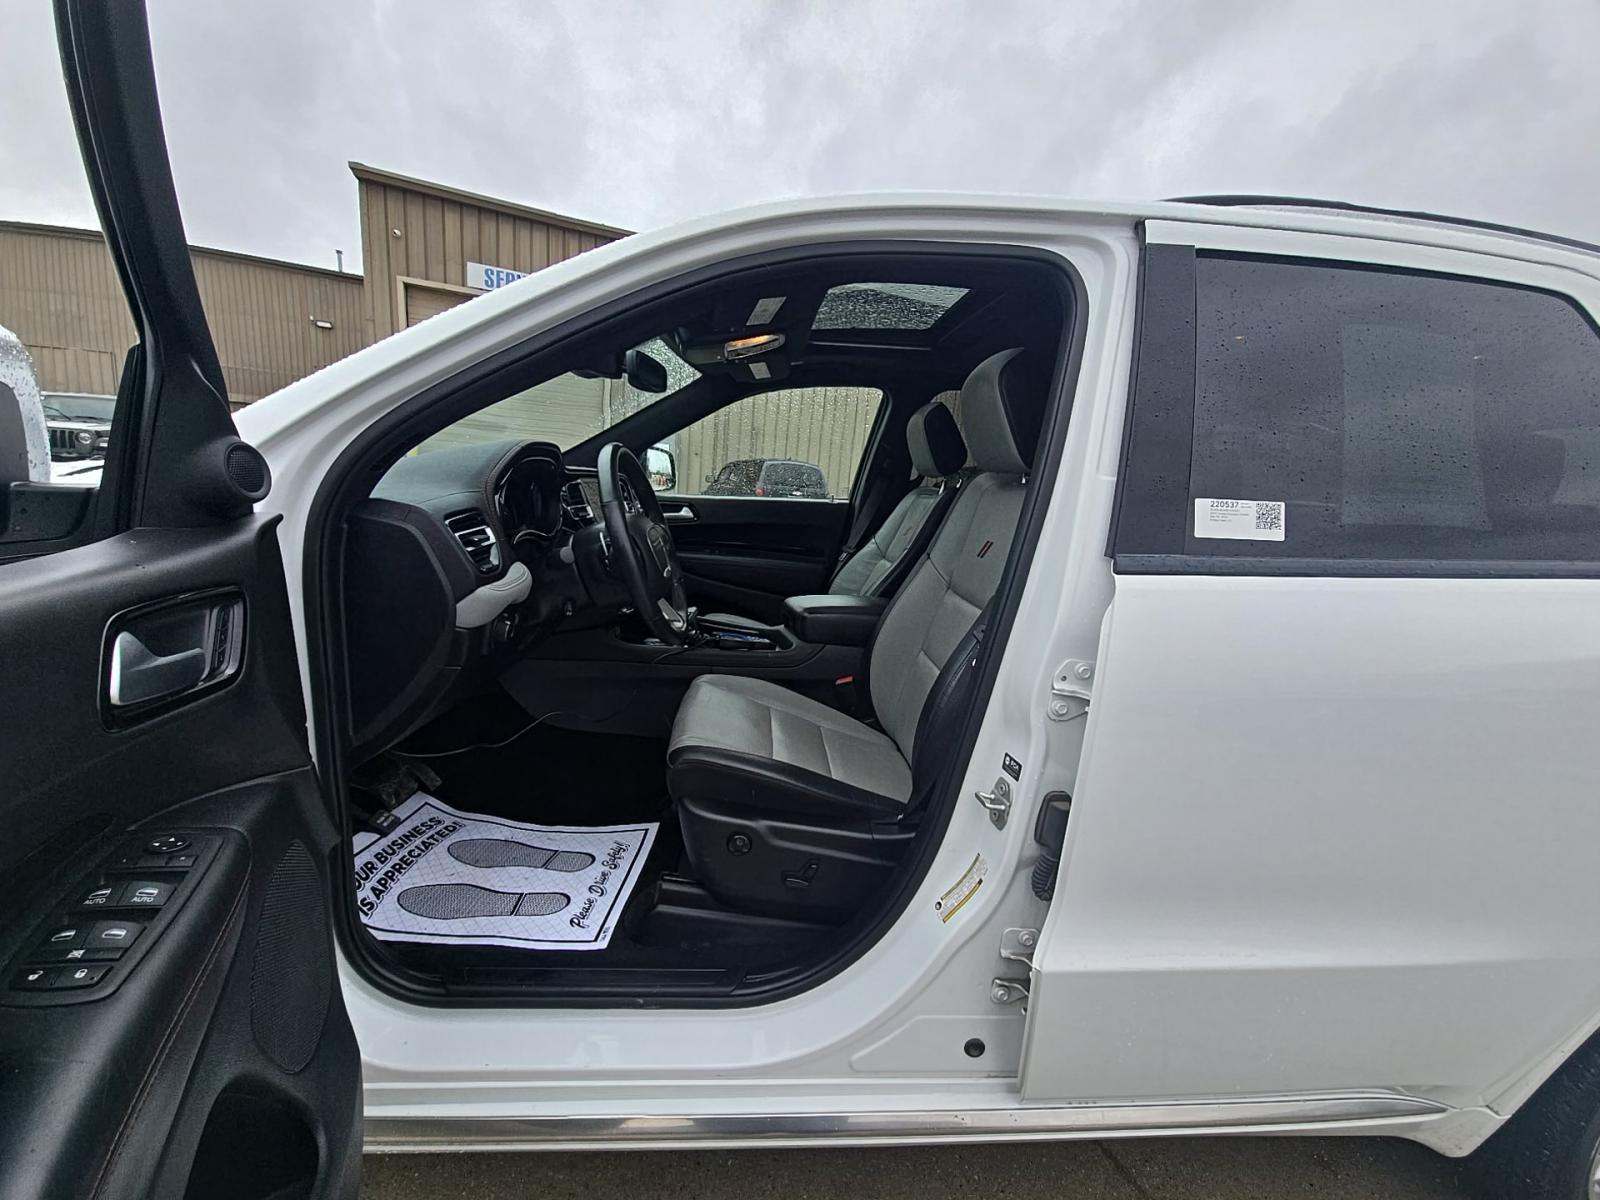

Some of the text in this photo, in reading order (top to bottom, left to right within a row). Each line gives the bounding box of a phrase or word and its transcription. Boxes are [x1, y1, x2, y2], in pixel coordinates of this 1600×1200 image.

[1210, 500, 1239, 509] 220537
[374, 816, 443, 865] BUSINESS
[359, 821, 463, 917] IS APPRECIATED!
[570, 898, 595, 929] Please
